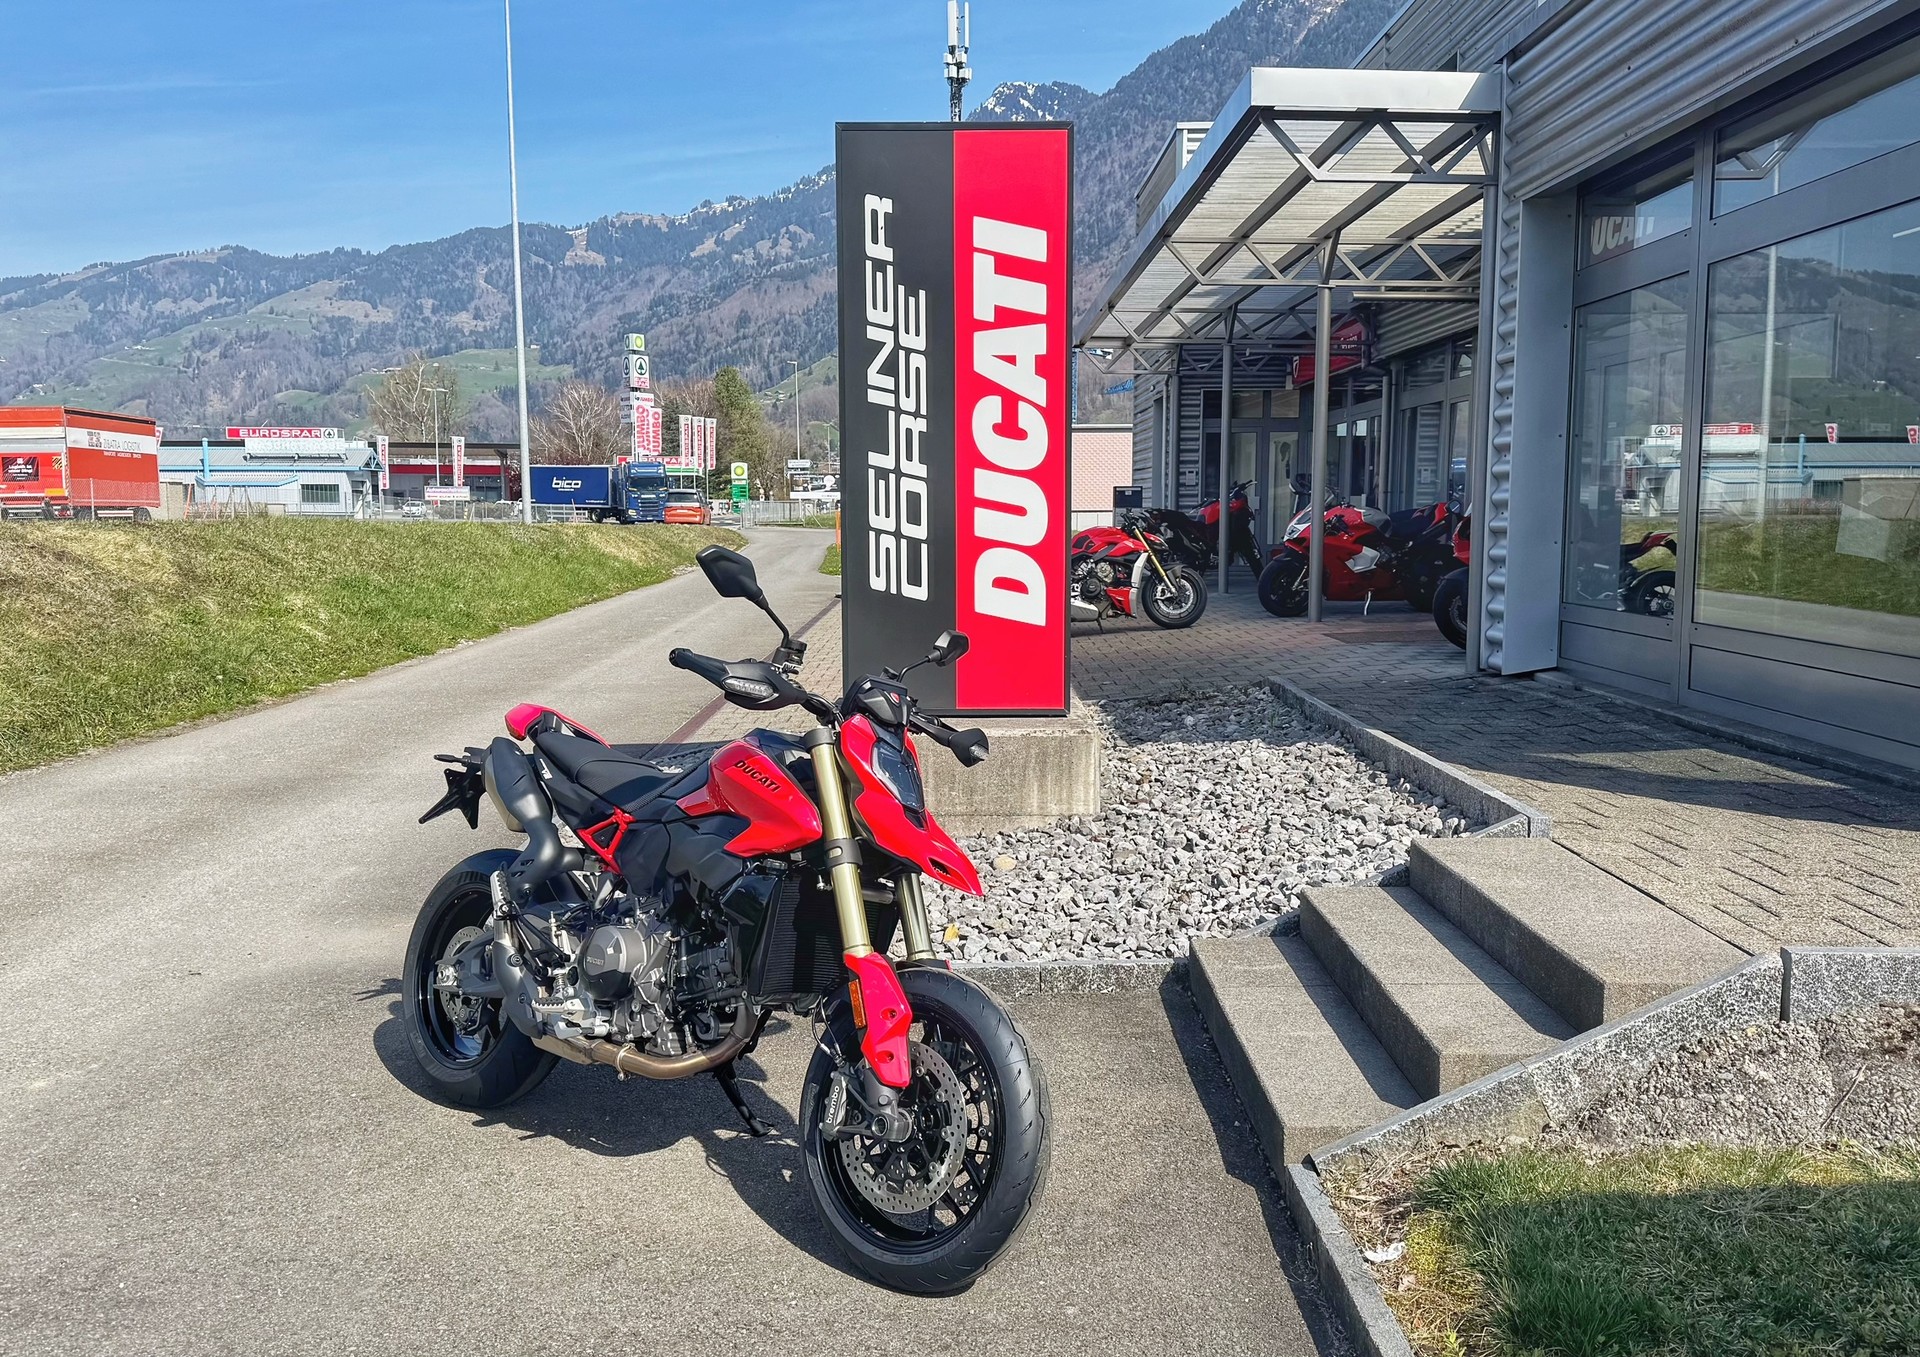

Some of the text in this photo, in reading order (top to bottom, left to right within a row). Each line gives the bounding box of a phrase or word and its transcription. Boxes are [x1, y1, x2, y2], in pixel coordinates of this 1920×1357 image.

[864, 193, 897, 596] SELINER
[636, 405, 646, 450] JUMBO
[652, 411, 660, 454] JUMBO
[898, 284, 928, 602] CORSE
[972, 216, 1048, 627] DUCATI
[552, 477, 582, 488] bico
[735, 760, 781, 792] DUCATI
[826, 1086, 840, 1124] brembo
